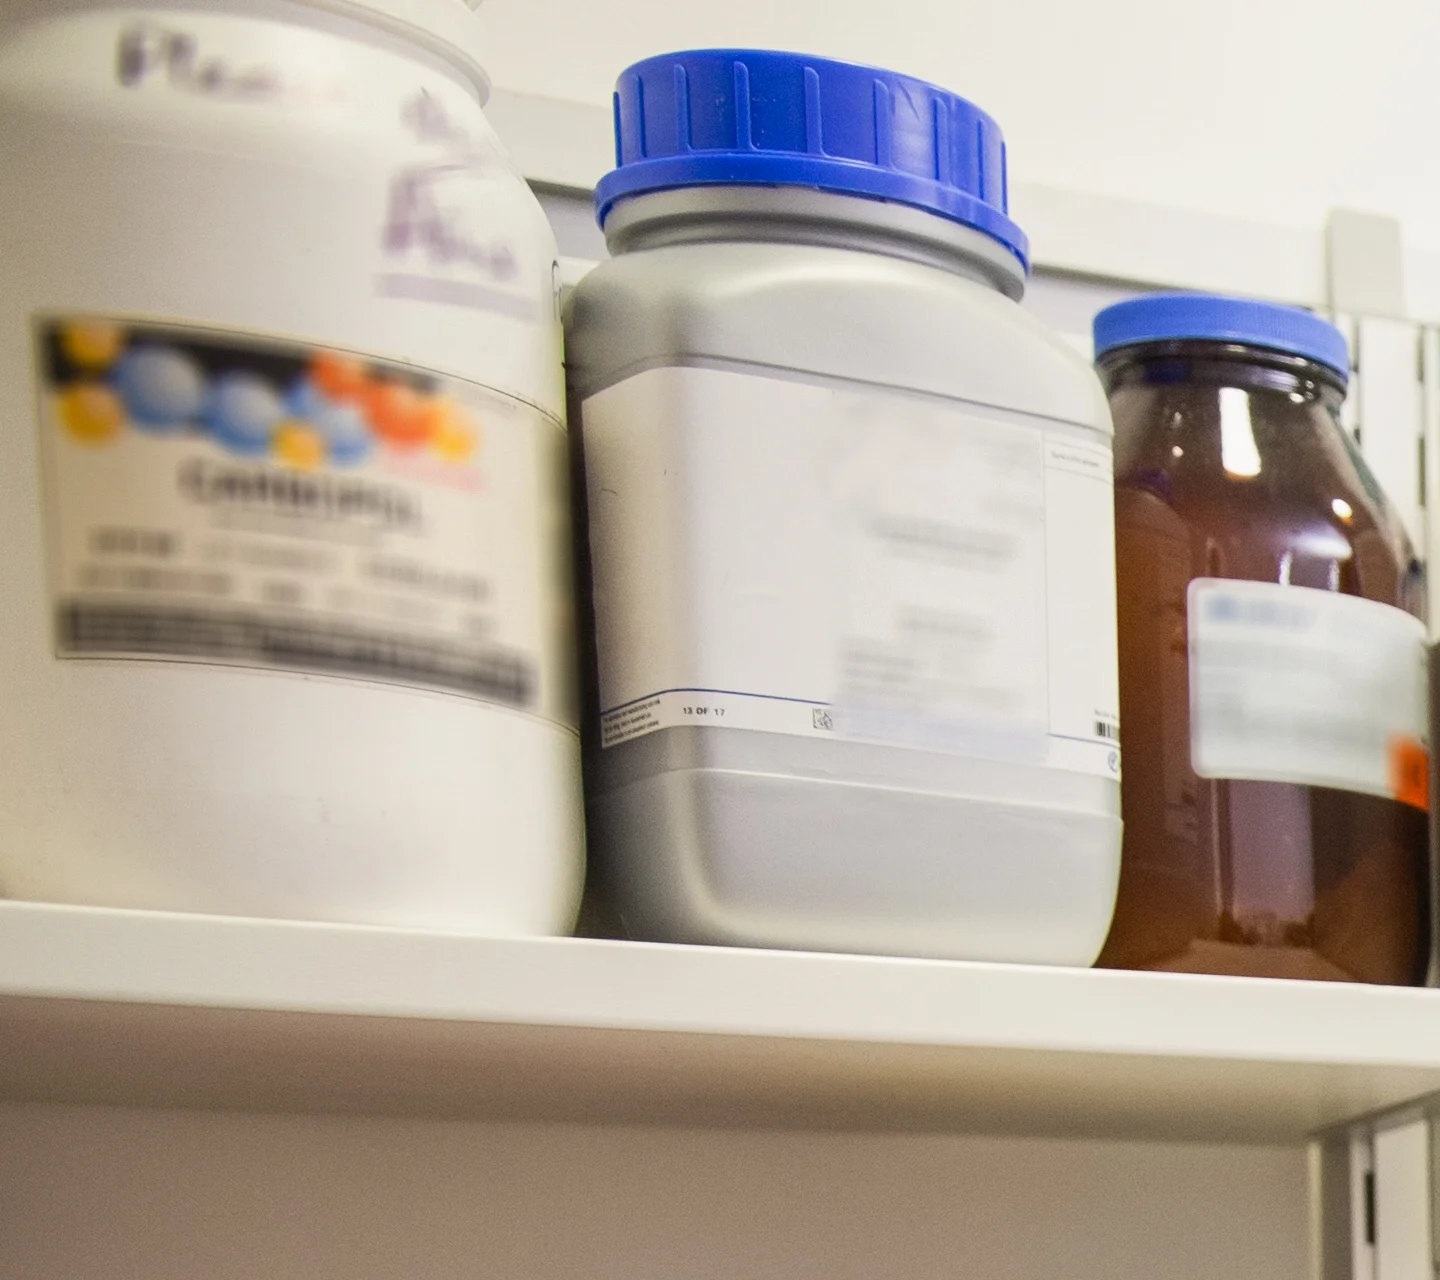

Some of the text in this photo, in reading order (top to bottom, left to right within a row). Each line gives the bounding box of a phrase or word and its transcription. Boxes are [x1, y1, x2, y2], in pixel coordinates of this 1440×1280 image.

[683, 706, 725, 717] 13 OF 17
